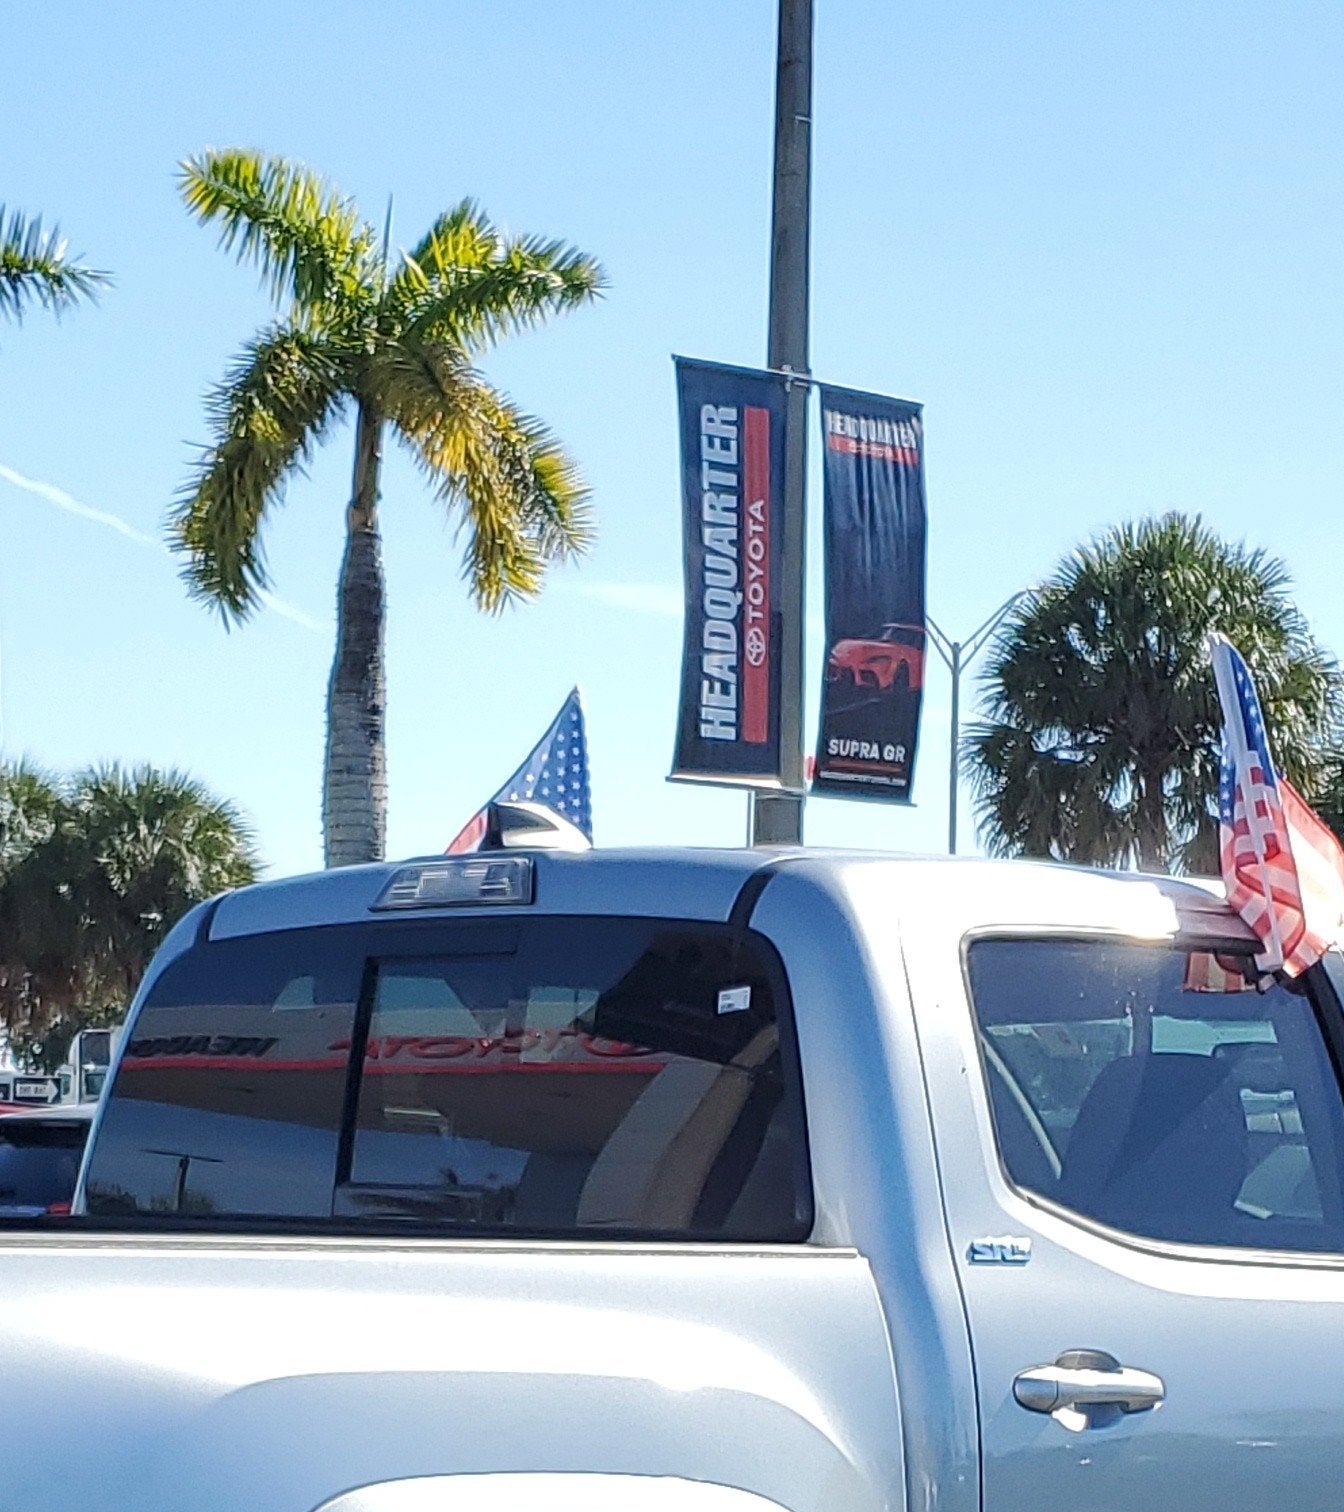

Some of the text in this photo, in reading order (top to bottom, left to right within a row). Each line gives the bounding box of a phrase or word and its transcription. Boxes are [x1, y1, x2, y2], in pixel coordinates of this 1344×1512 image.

[700, 404, 743, 740] HEADQUARTER
[748, 499, 765, 623] TOYOTA
[828, 739, 906, 763] SUPRA GR
